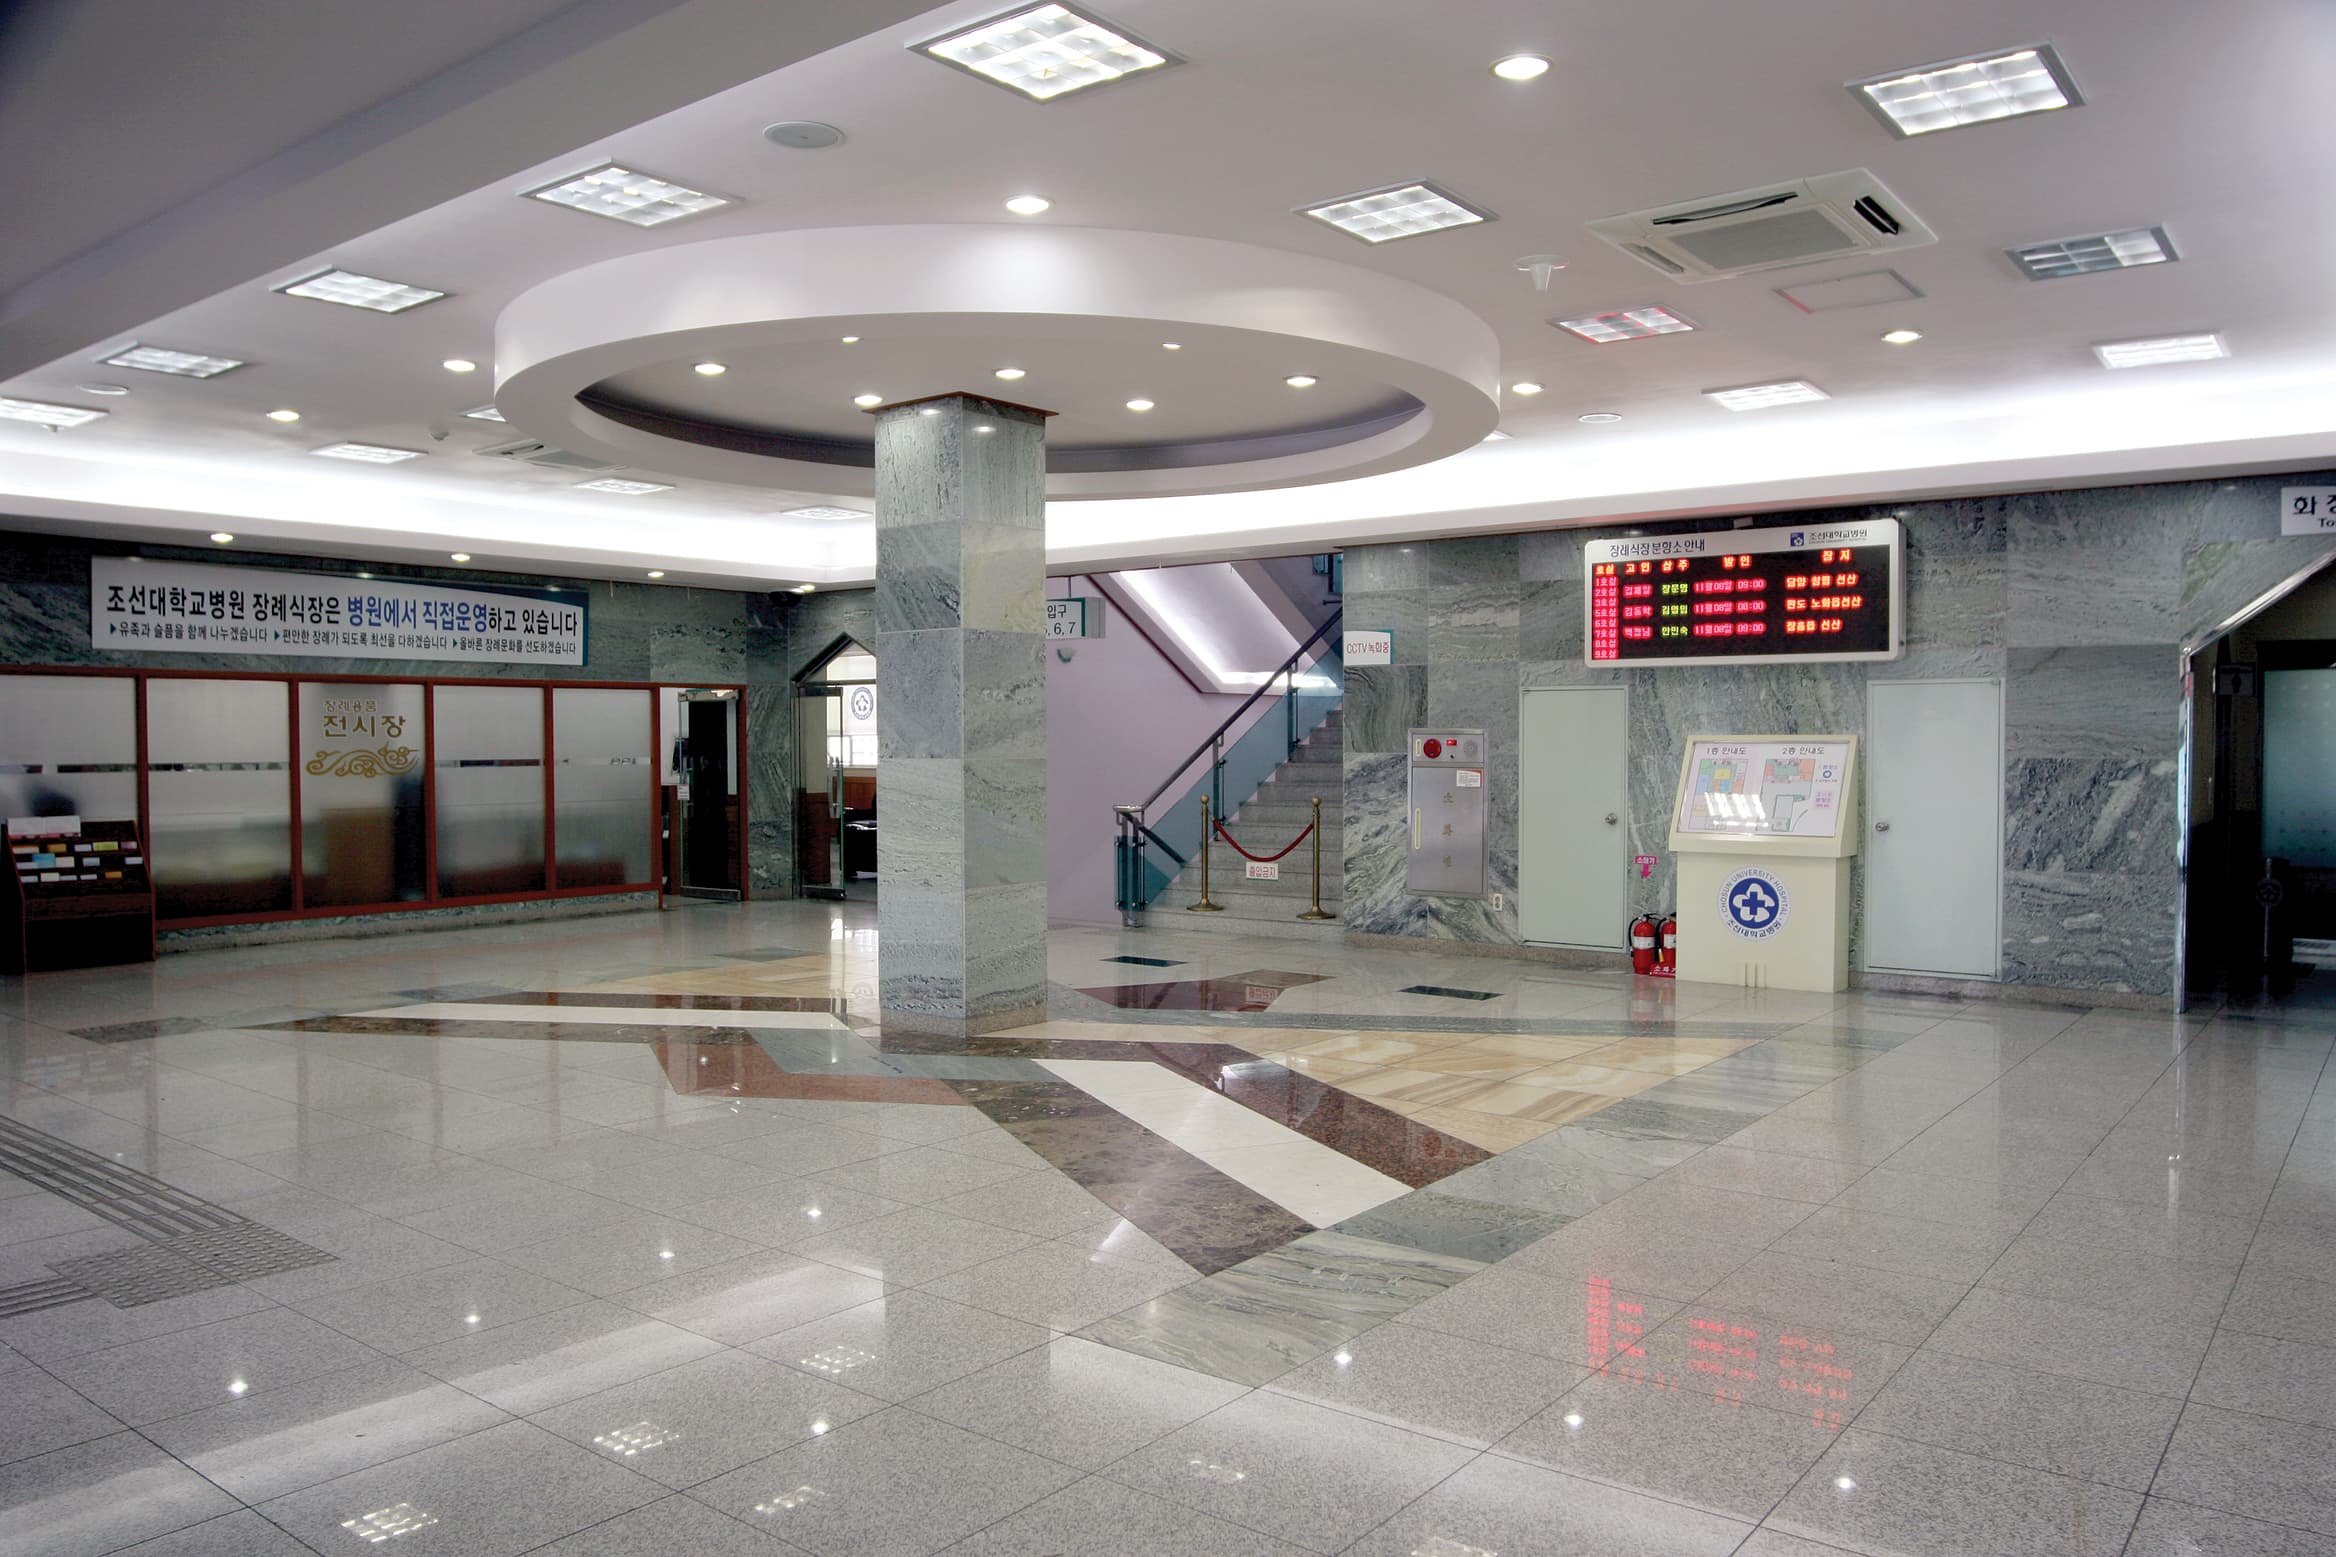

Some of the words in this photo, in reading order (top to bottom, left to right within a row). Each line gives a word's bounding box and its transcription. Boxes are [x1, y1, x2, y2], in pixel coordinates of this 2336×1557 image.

[1808, 528, 1868, 539] 조선대학교병원
[1609, 543, 1650, 558] 장례식장
[1651, 541, 1683, 555] 분향소
[1684, 538, 1705, 553] 안내
[106, 585, 245, 620] 조선대학교병원
[253, 593, 341, 624] 장례식장은
[347, 596, 417, 629] 병원에서
[422, 600, 517, 633] 직접운영하고
[522, 608, 578, 637] 있습니다
[119, 621, 150, 639] 유족과
[154, 624, 184, 640] 슬픔을
[188, 625, 207, 640] 함께
[210, 626, 268, 643] 나누겠습니다
[282, 630, 310, 644] 편안한
[313, 631, 340, 646] 장례가
[342, 632, 368, 646] 되도록
[371, 633, 396, 648] 최선을
[398, 635, 448, 650] 다하겠습니다
[459, 637, 483, 651] 올바른
[486, 639, 523, 653] 장례문화를
[525, 640, 577, 656] 선도하겠습니다
[324, 700, 377, 713] 장례용품
[323, 715, 406, 738] 전시장
[1249, 865, 1276, 878] 출입금지
[1721, 882, 1733, 913] CHOSUN
[1731, 869, 1775, 883] UNIVERSITY
[1774, 880, 1788, 915] HOSPITAL
